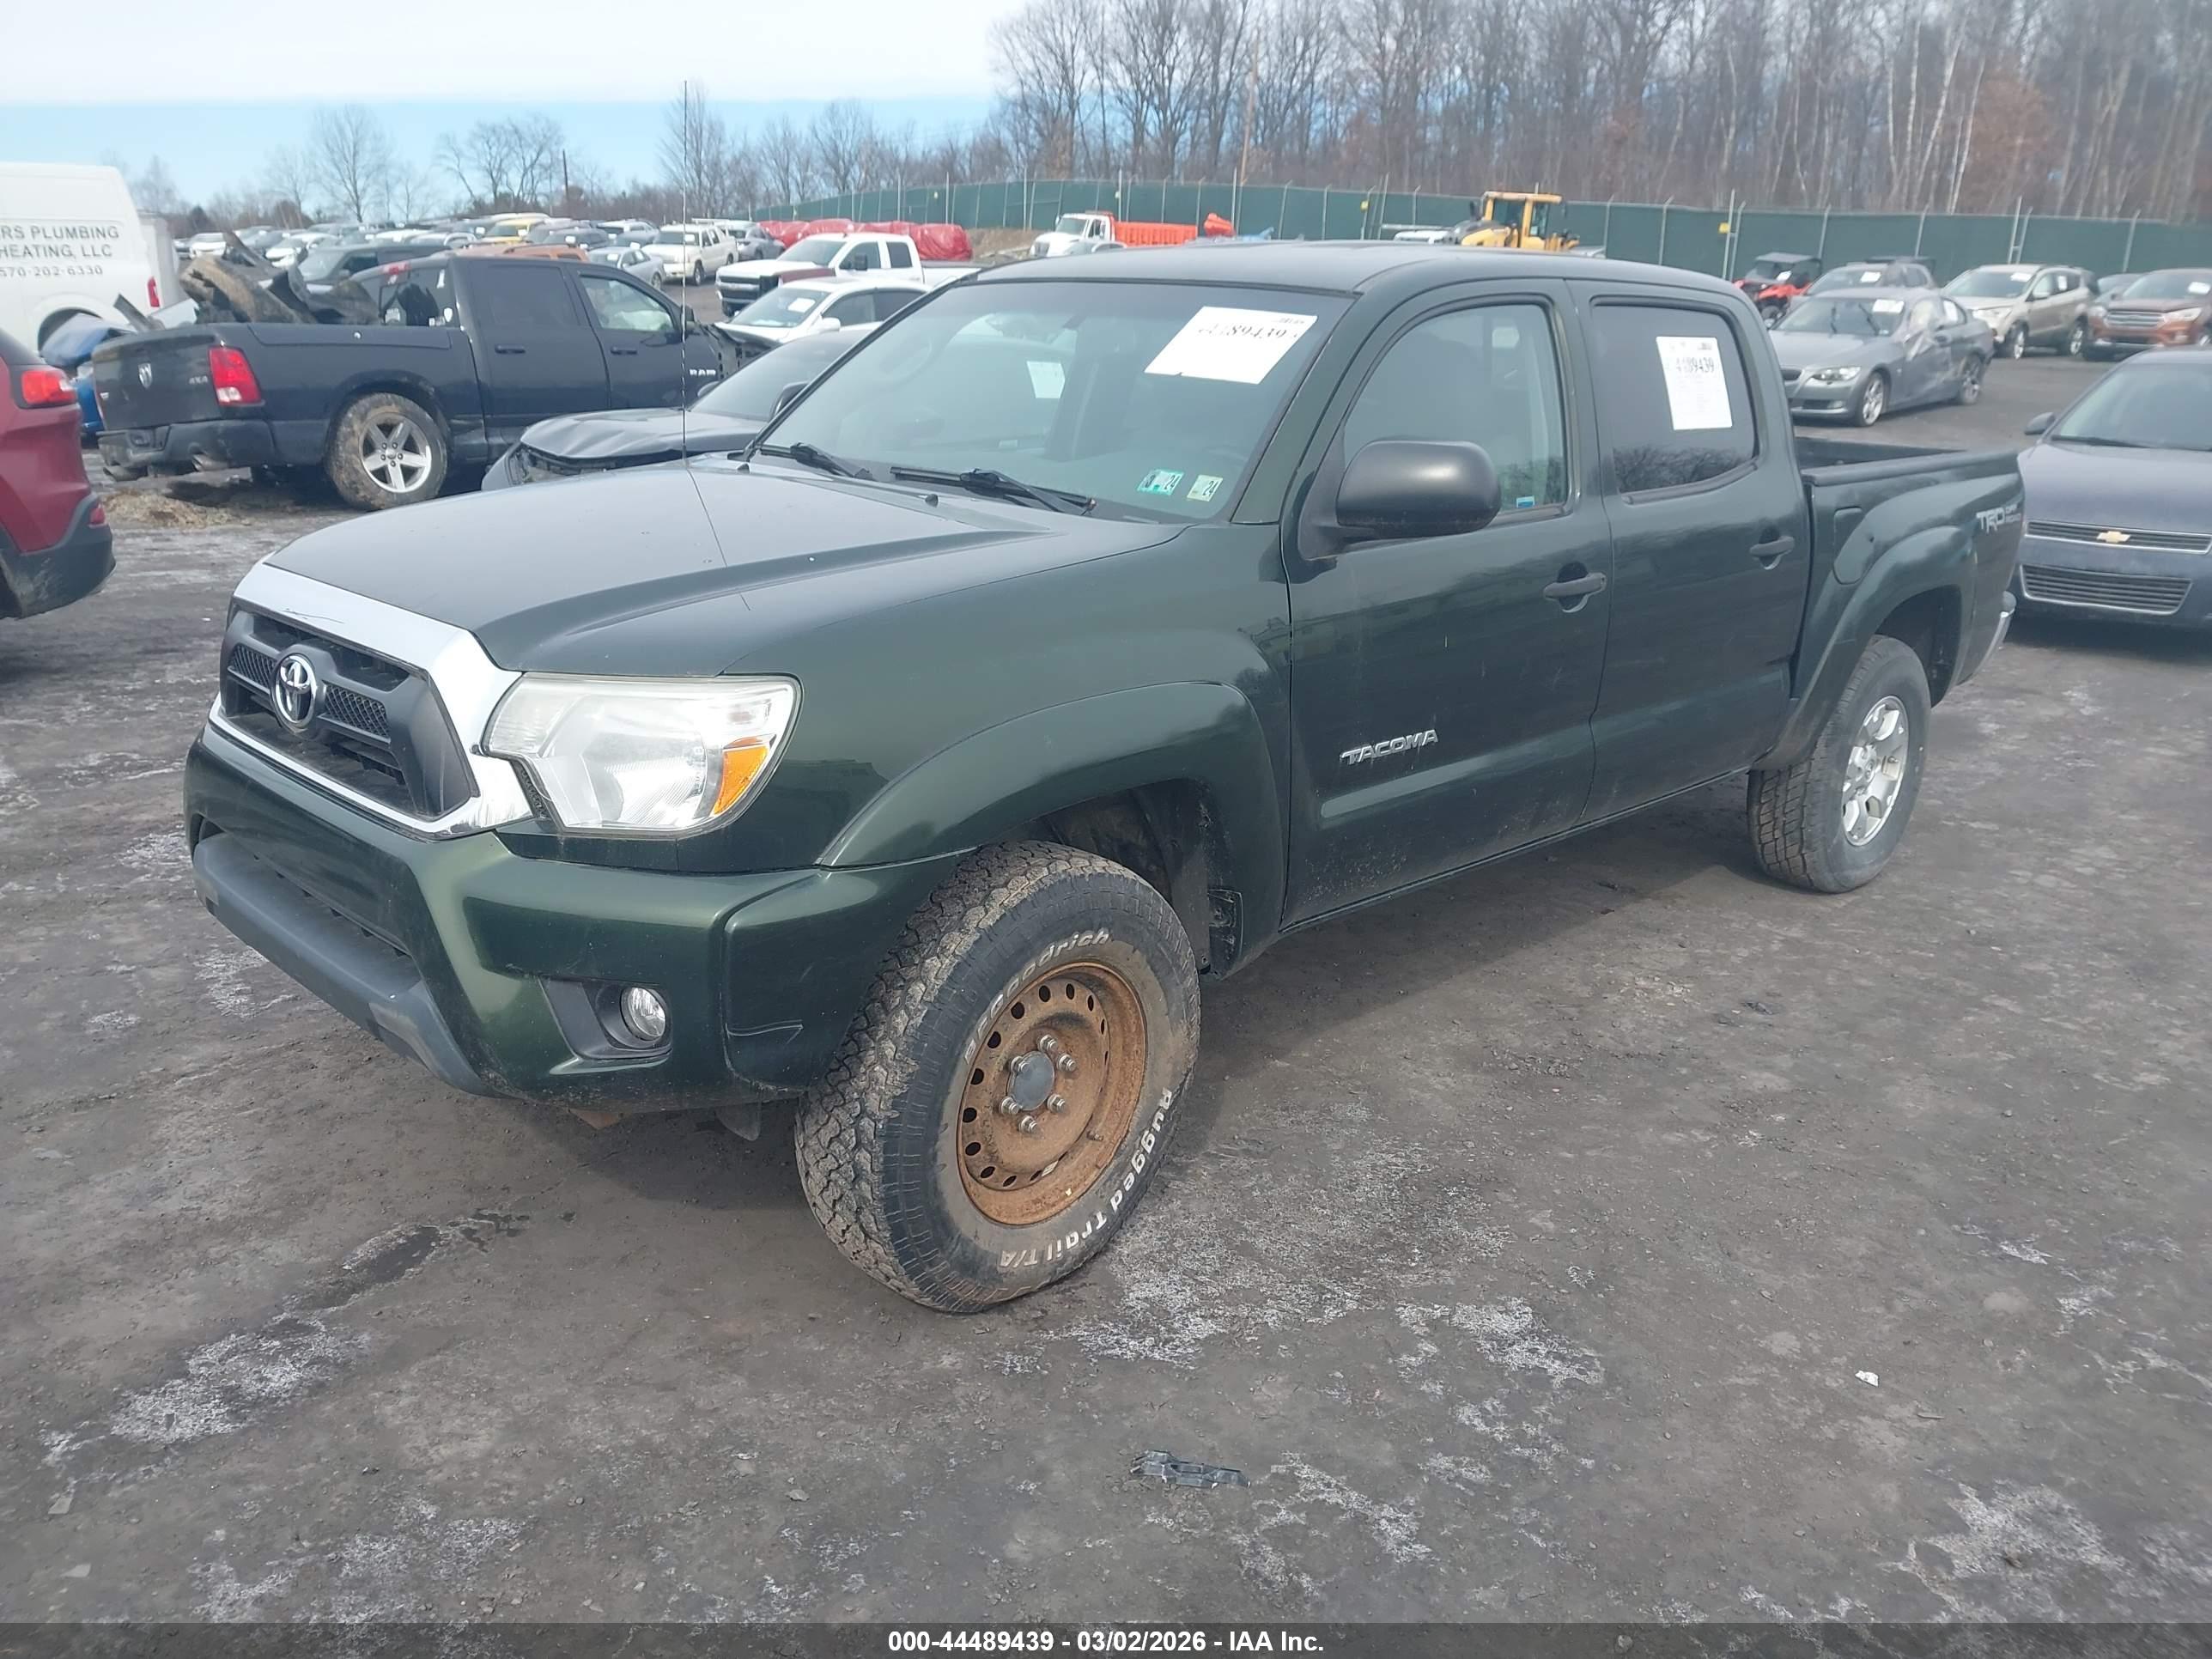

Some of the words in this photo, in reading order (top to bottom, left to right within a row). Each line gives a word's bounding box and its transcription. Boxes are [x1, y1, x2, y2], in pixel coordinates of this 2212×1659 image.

[30, 225, 119, 240] PLUMBING
[81, 244, 112, 258] LLC
[1202, 480, 1219, 497] 24
[1976, 507, 2005, 534] TRD
[1340, 729, 1439, 765] TACOMA
[1110, 1087, 1173, 1212] Rugged
[1046, 1210, 1108, 1261] Trail
[999, 1248, 1038, 1269] T/A
